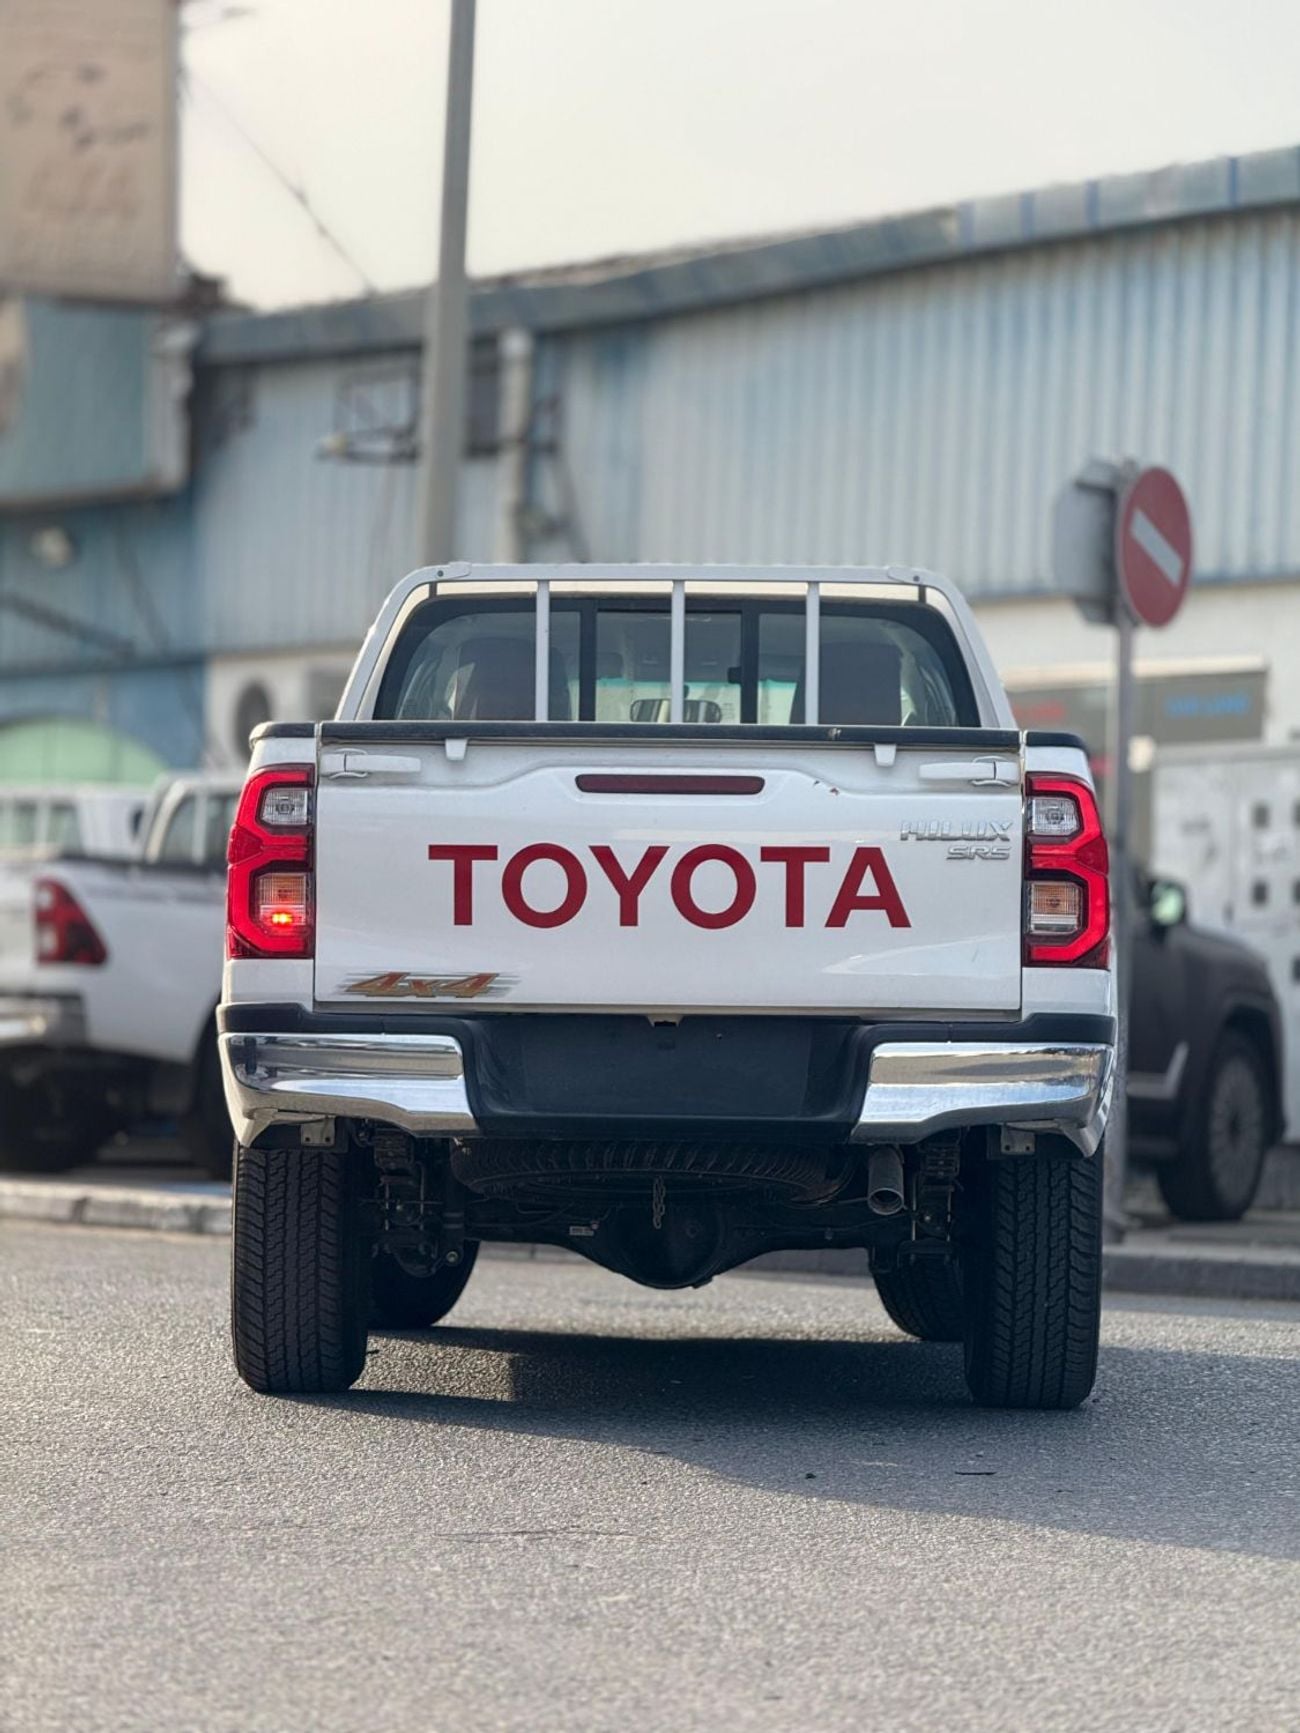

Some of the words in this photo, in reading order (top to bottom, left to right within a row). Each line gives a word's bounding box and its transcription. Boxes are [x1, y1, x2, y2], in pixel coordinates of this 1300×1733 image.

[900, 819, 1013, 842] HILUX
[946, 844, 1012, 861] SRS
[428, 843, 912, 930] TOYOTA
